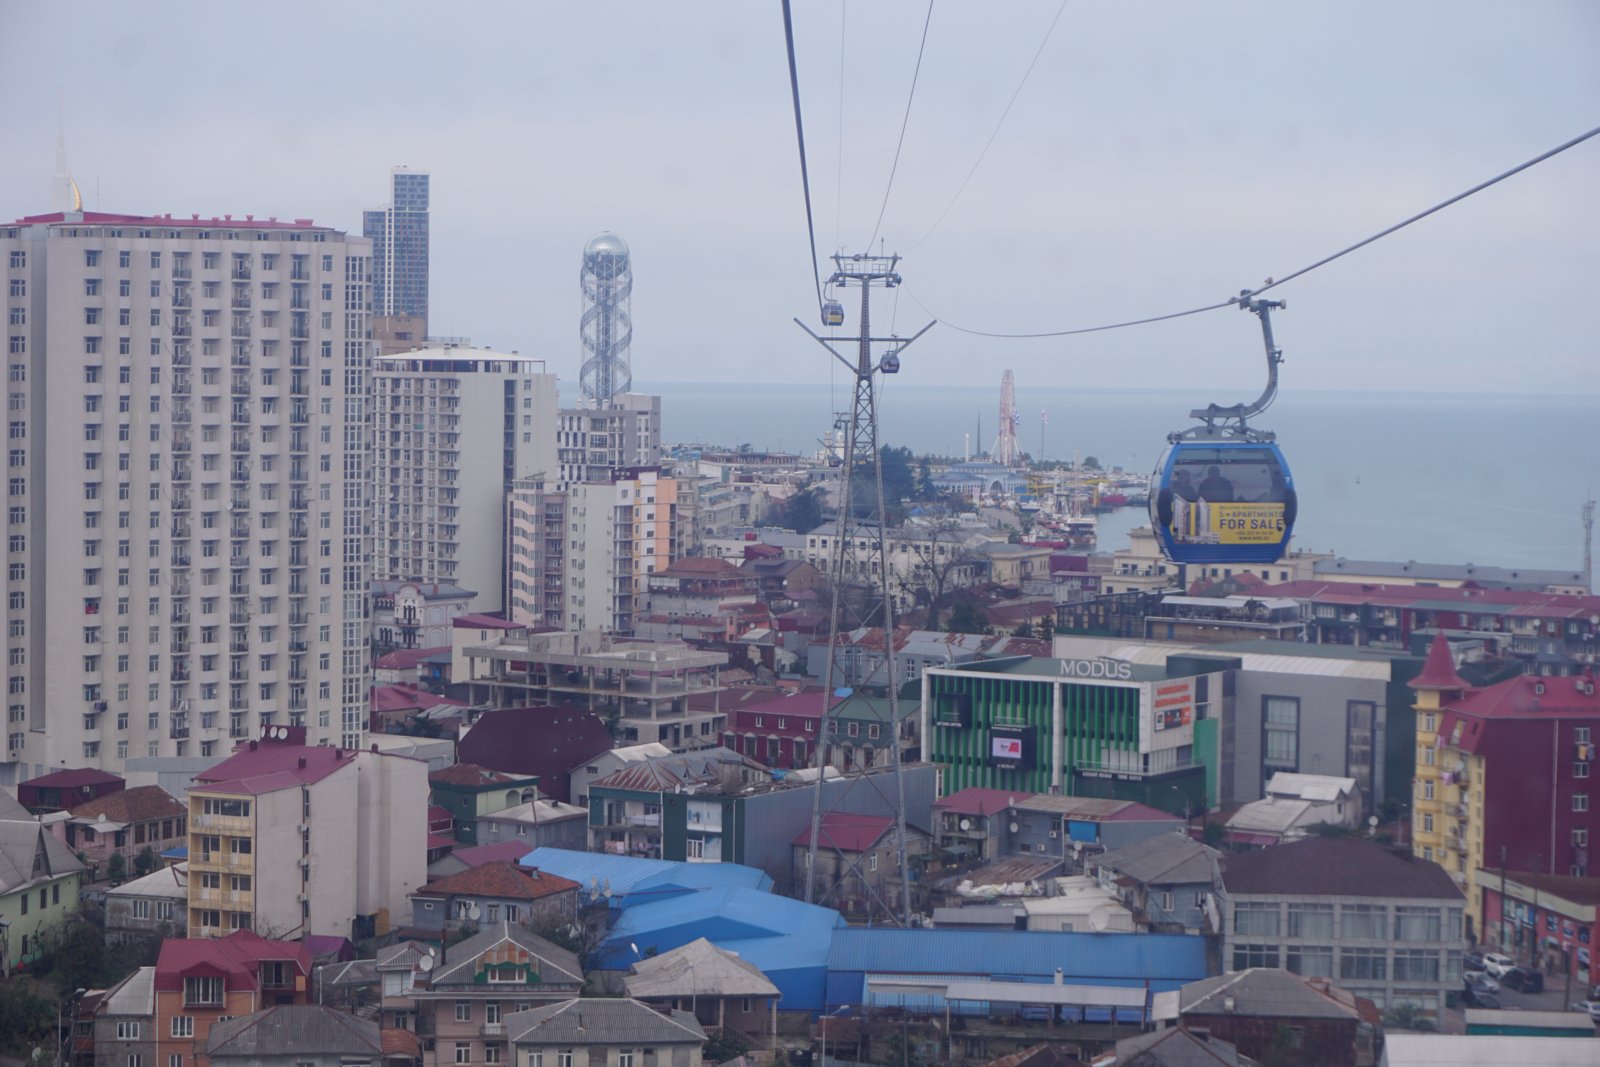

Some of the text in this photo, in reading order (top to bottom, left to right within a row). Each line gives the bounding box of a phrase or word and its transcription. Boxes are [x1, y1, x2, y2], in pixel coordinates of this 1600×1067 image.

[1219, 518, 1284, 530] FOR SALE
[1060, 659, 1132, 680] MODUS
